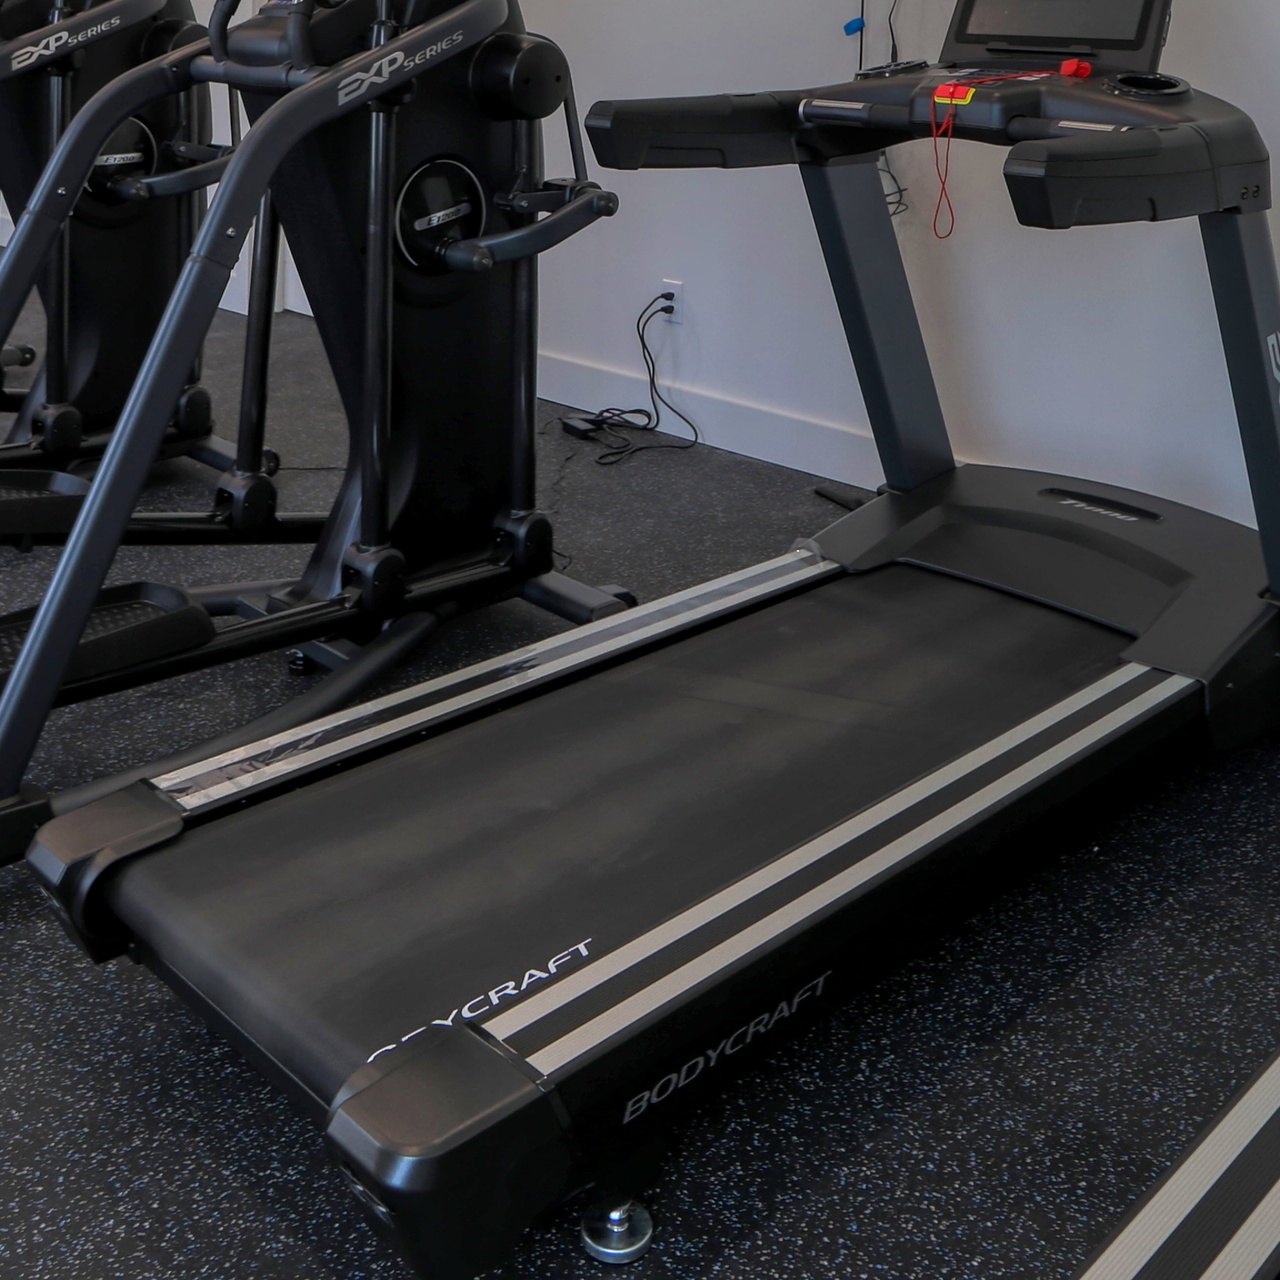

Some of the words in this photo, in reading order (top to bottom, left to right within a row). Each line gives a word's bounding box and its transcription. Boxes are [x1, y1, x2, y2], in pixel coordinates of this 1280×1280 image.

[11, 31, 69, 71] EXP
[67, 16, 121, 47] SERIES
[337, 51, 405, 106] EXP
[403, 30, 464, 72] SERIES
[427, 208, 461, 226] E1200
[367, 938, 592, 1063] YCRAFT
[623, 971, 832, 1124] BODYCRAFT
